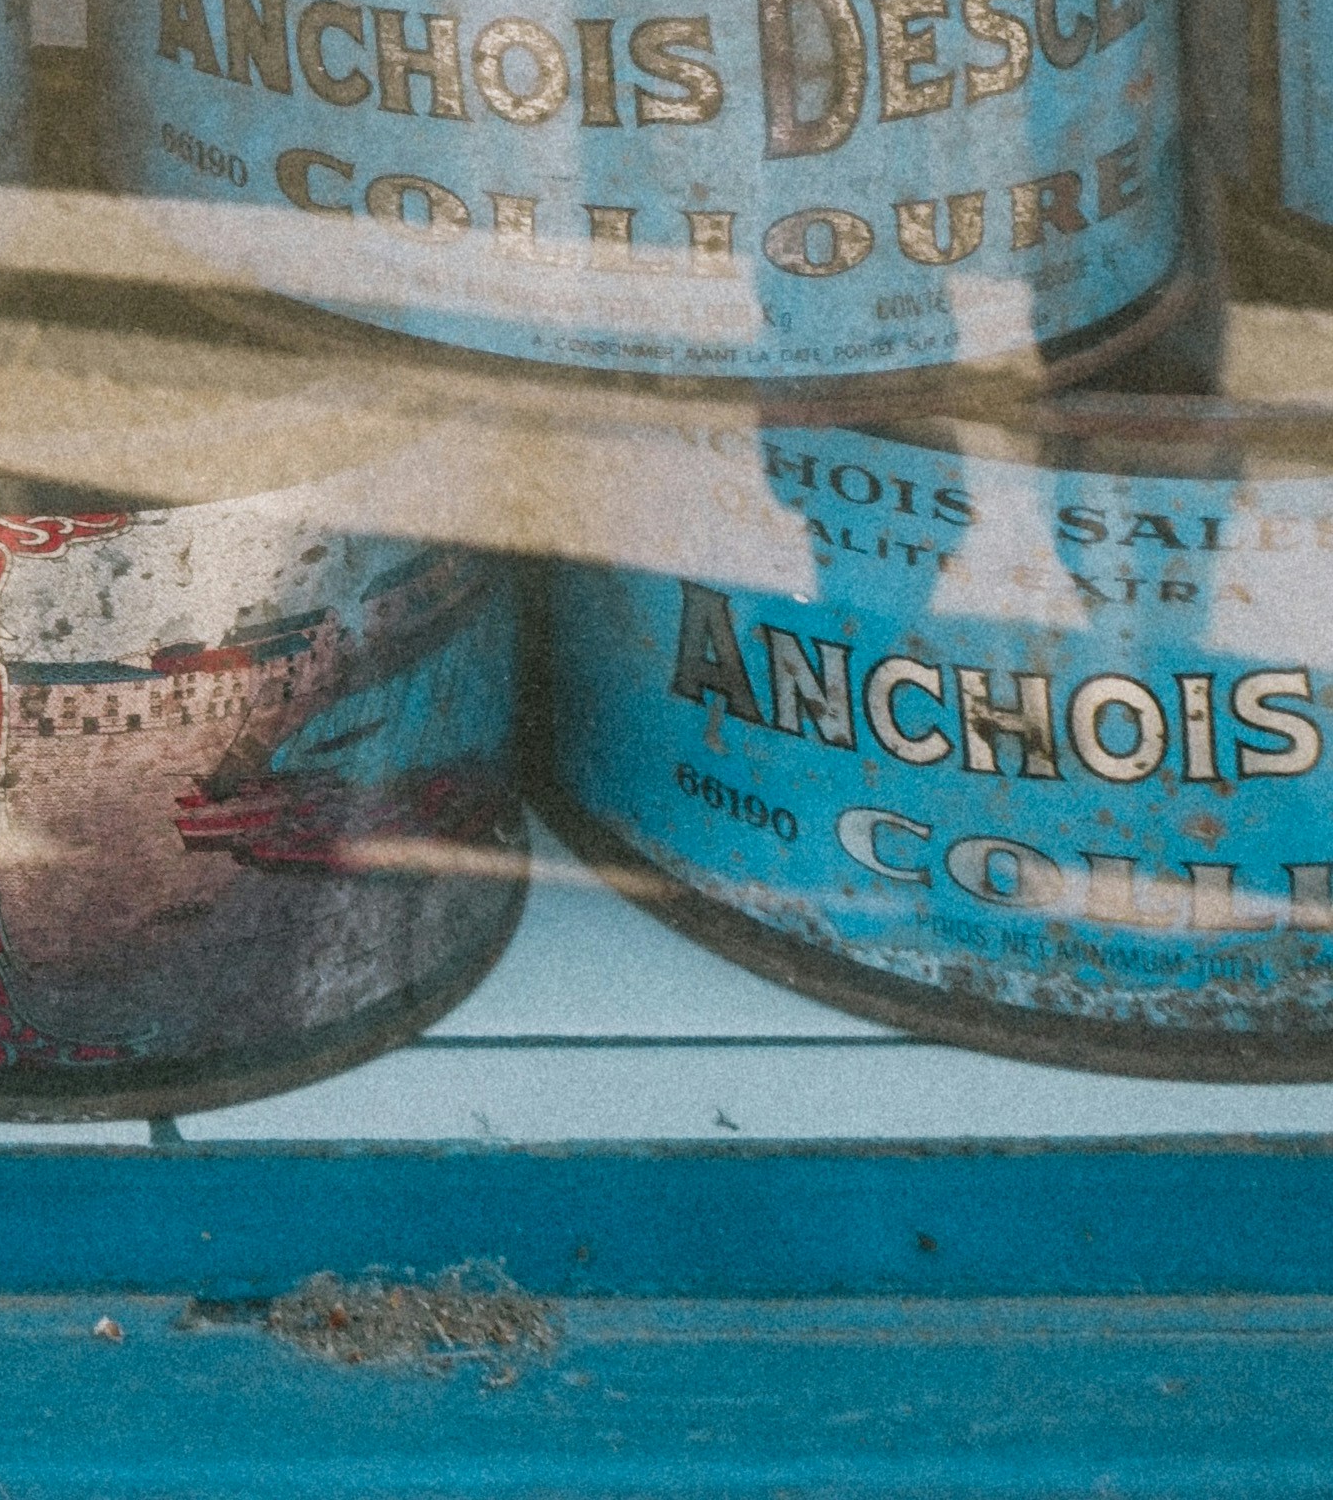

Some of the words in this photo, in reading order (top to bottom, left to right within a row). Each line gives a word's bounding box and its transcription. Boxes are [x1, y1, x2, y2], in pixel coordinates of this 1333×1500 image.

[274, 143, 1141, 280] COLLIOURE
[666, 577, 1323, 783] ANCHOIS
[674, 759, 800, 845] 66190
